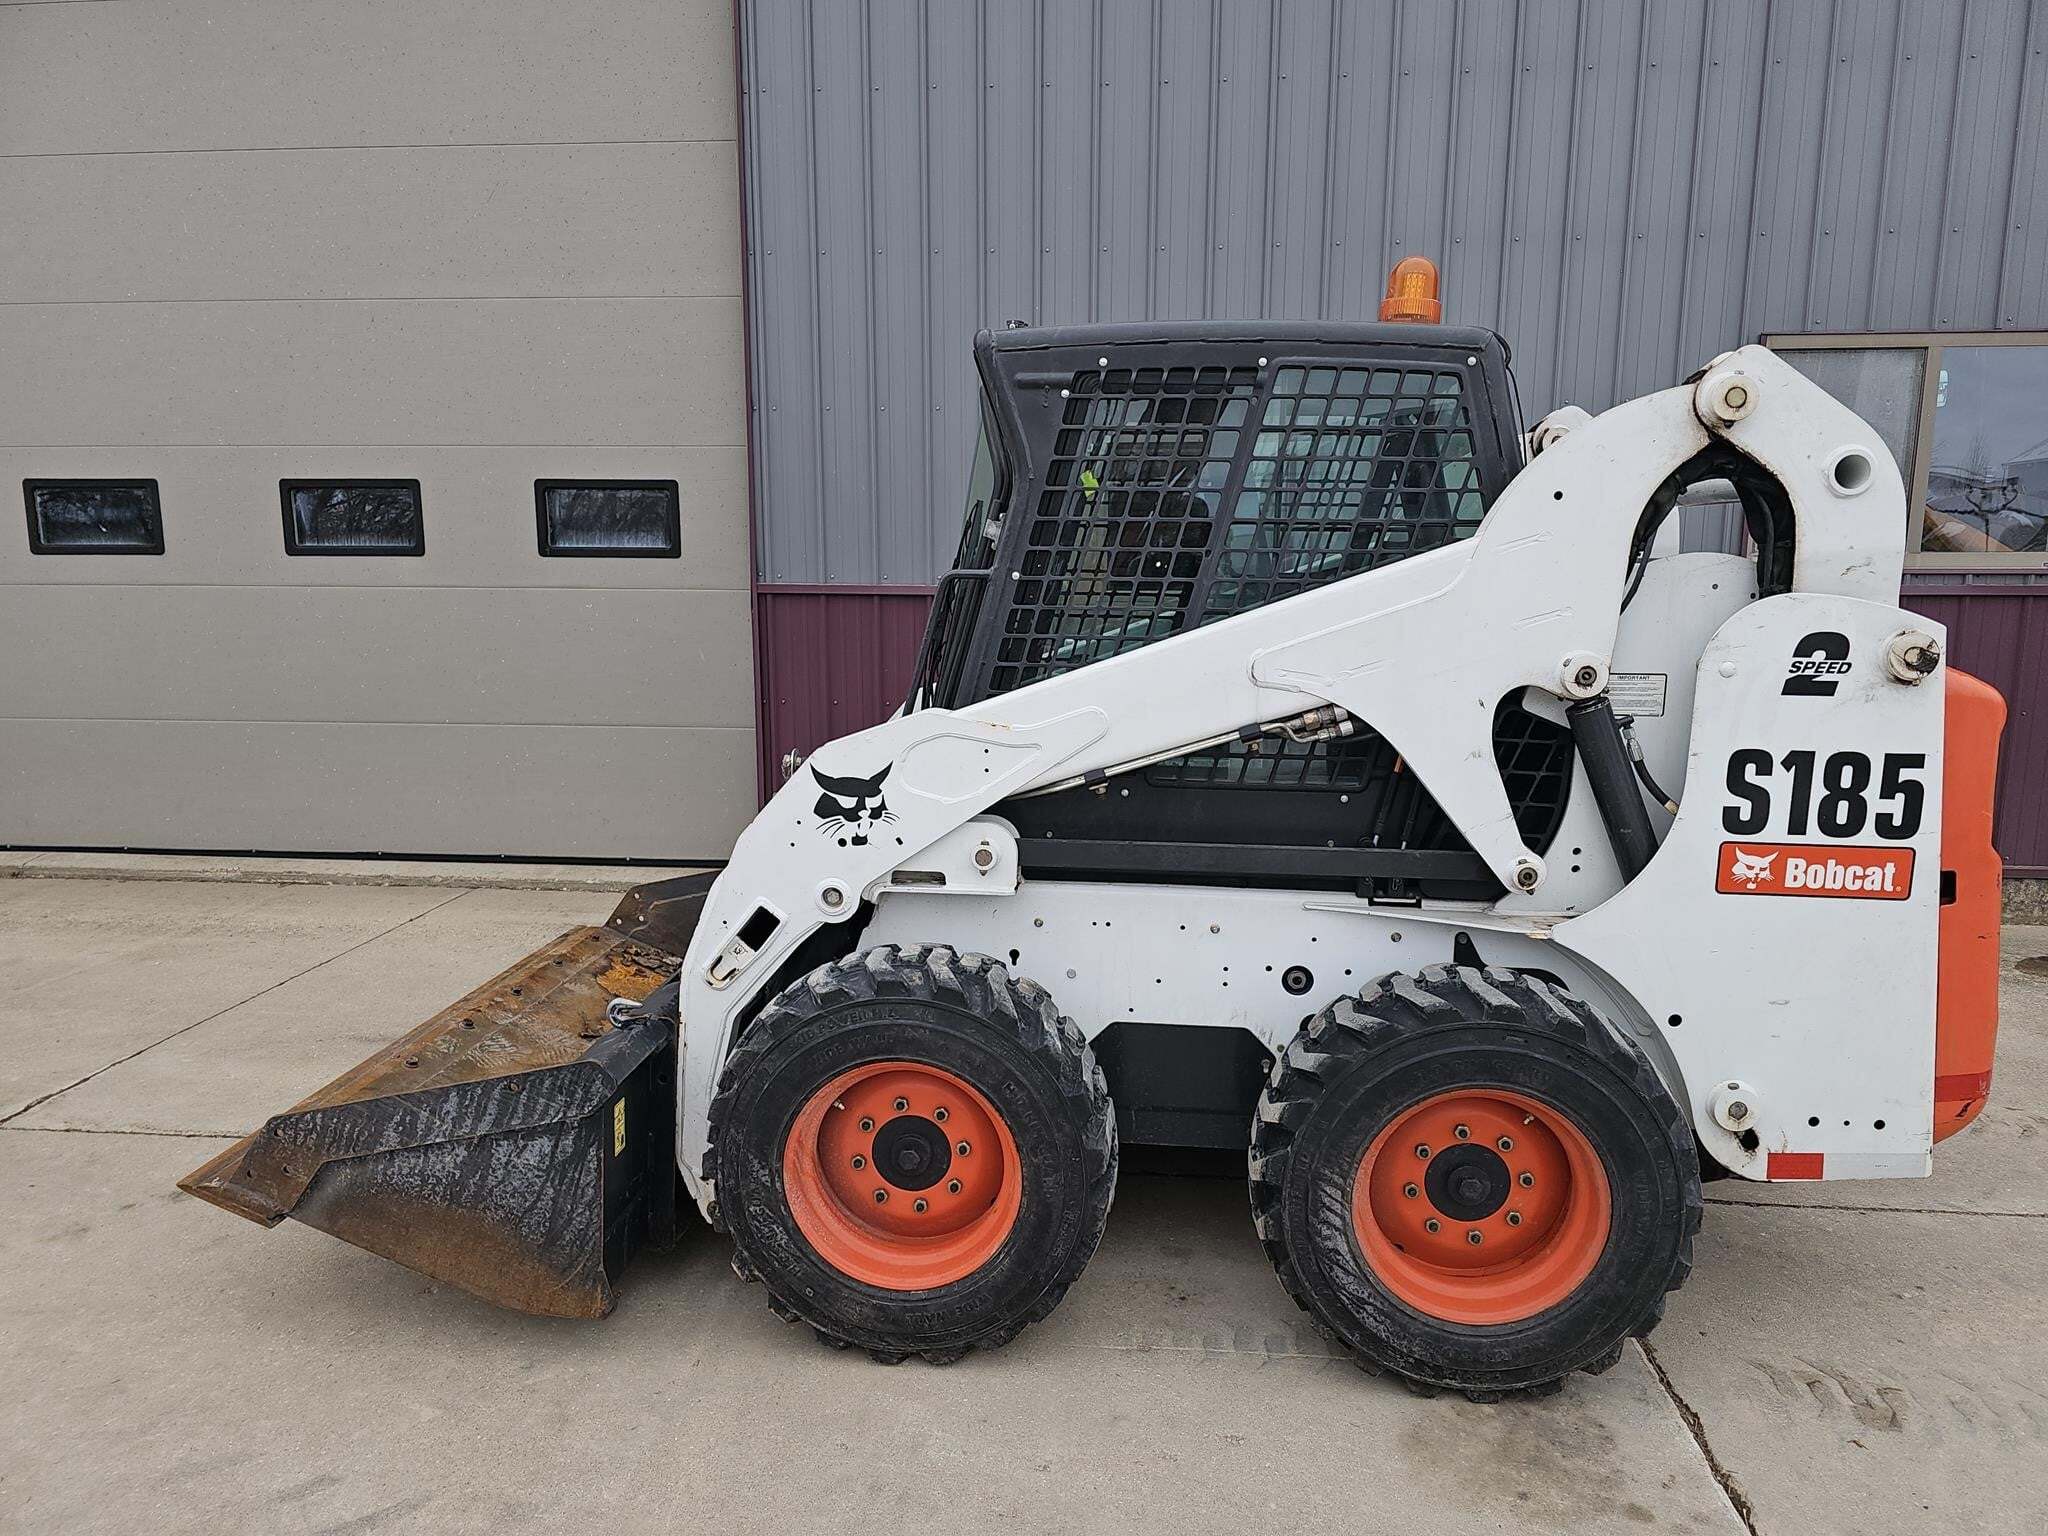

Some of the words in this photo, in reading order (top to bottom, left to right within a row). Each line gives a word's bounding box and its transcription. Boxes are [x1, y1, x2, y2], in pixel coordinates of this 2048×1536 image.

[1781, 631, 1850, 697] 2
[1788, 660, 1852, 674] SPEED
[1722, 748, 1926, 840] S185
[1784, 857, 1896, 891] Bobcat
